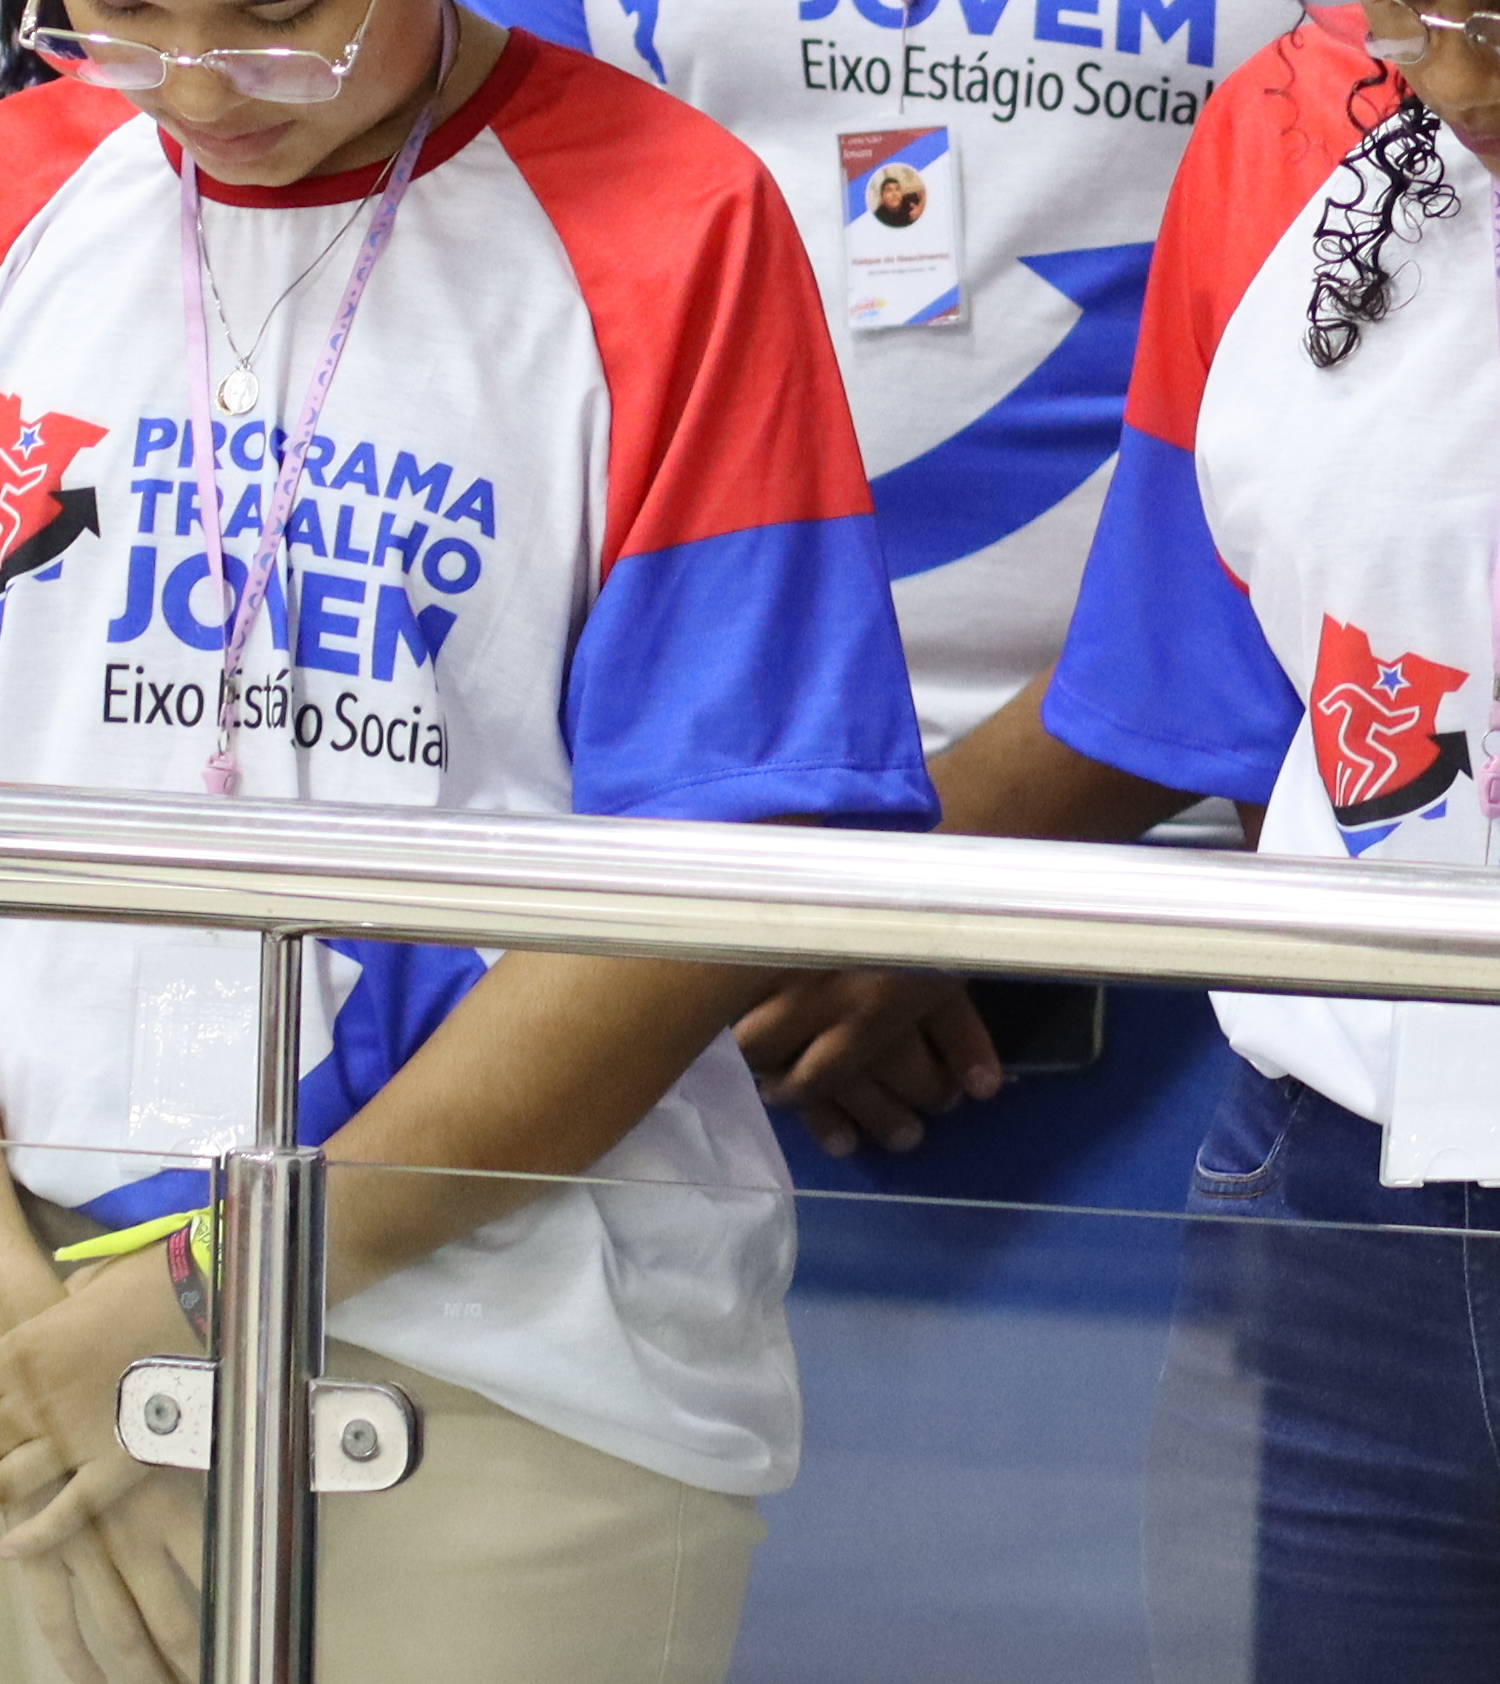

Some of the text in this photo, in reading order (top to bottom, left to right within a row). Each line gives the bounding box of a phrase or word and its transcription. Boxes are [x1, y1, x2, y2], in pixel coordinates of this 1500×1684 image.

[801, 38, 891, 96] Eixo
[902, 45, 1065, 123] Estágio
[102, 662, 205, 728] Eixo
[330, 690, 449, 772] Social
